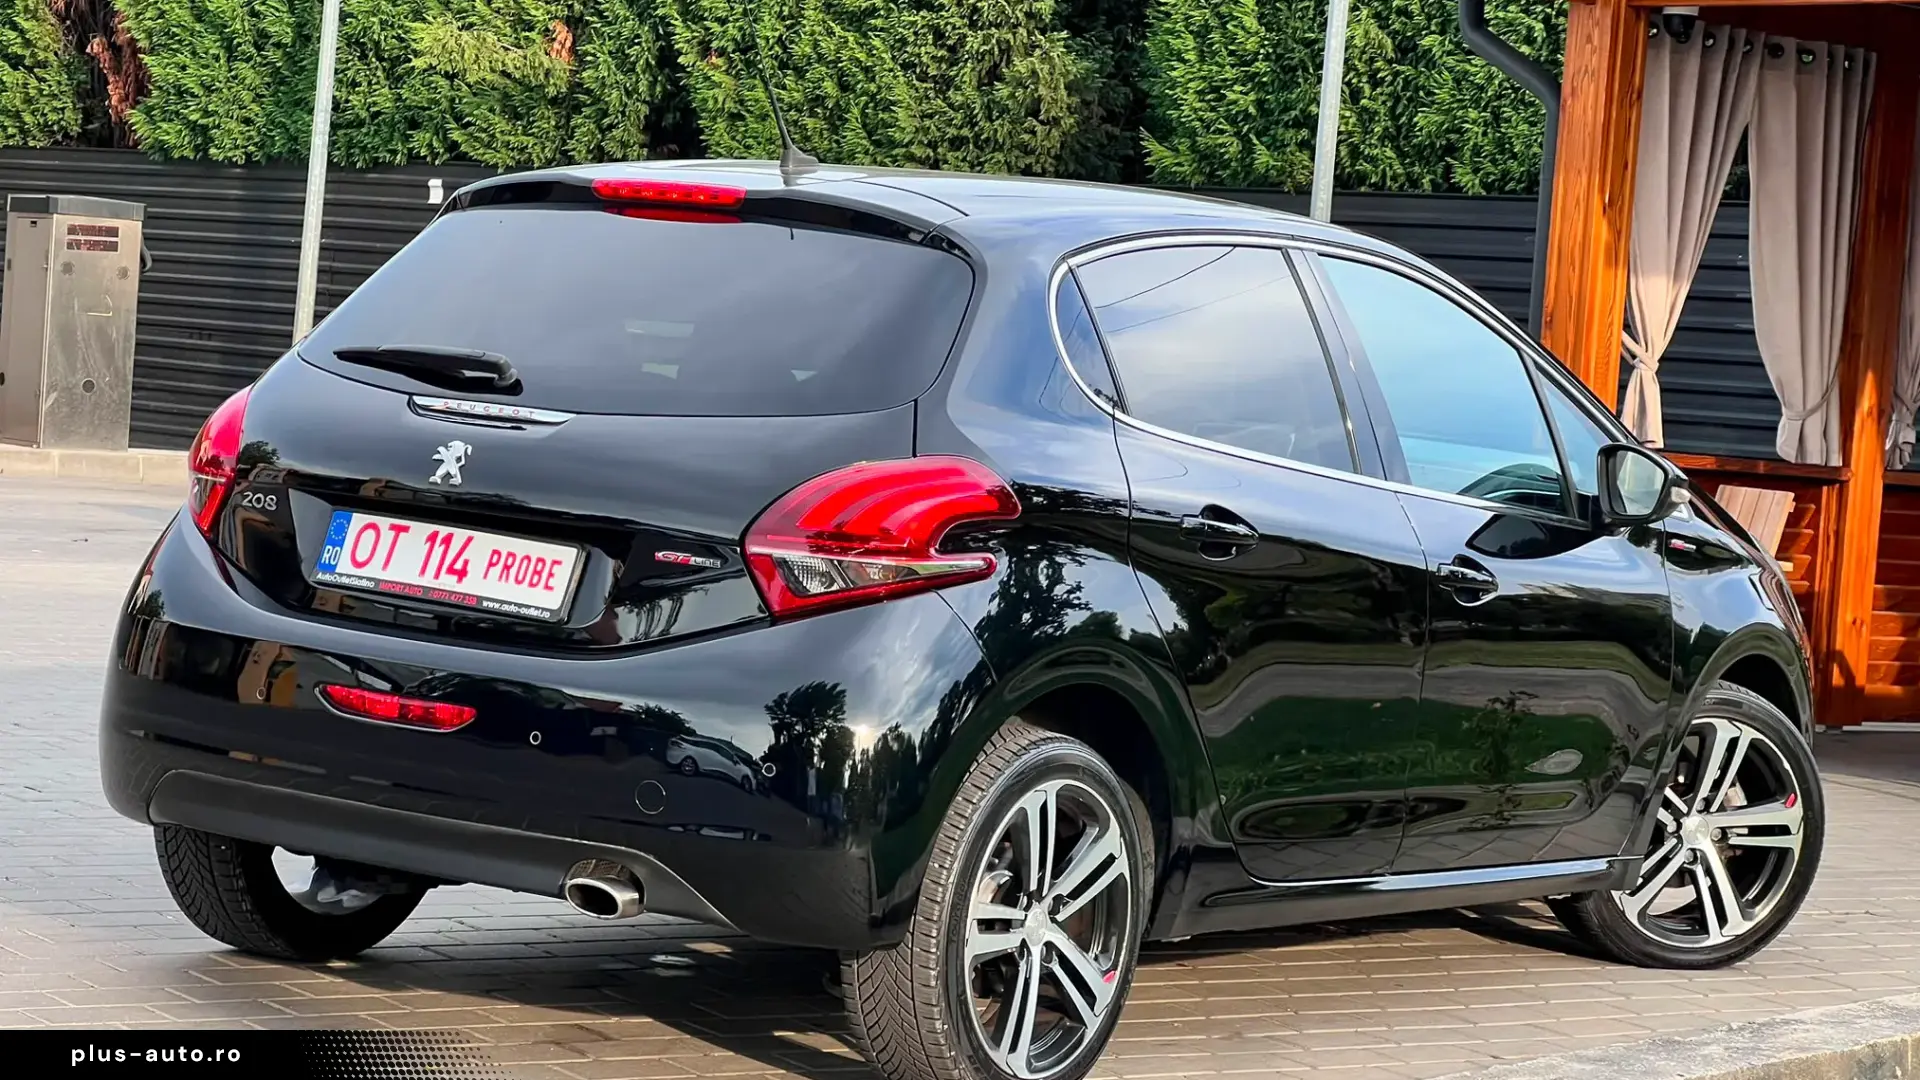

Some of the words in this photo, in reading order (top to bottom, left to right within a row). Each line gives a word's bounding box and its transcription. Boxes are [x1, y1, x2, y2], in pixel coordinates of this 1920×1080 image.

[443, 401, 536, 419] PEUGEOT
[242, 491, 278, 511] 208
[321, 545, 340, 565] RO
[349, 521, 411, 573] OT
[418, 530, 475, 585] 114
[482, 549, 563, 592] PROBE
[655, 551, 692, 565] GT
[379, 580, 404, 593] IMPORT
[404, 584, 423, 596] AUTO
